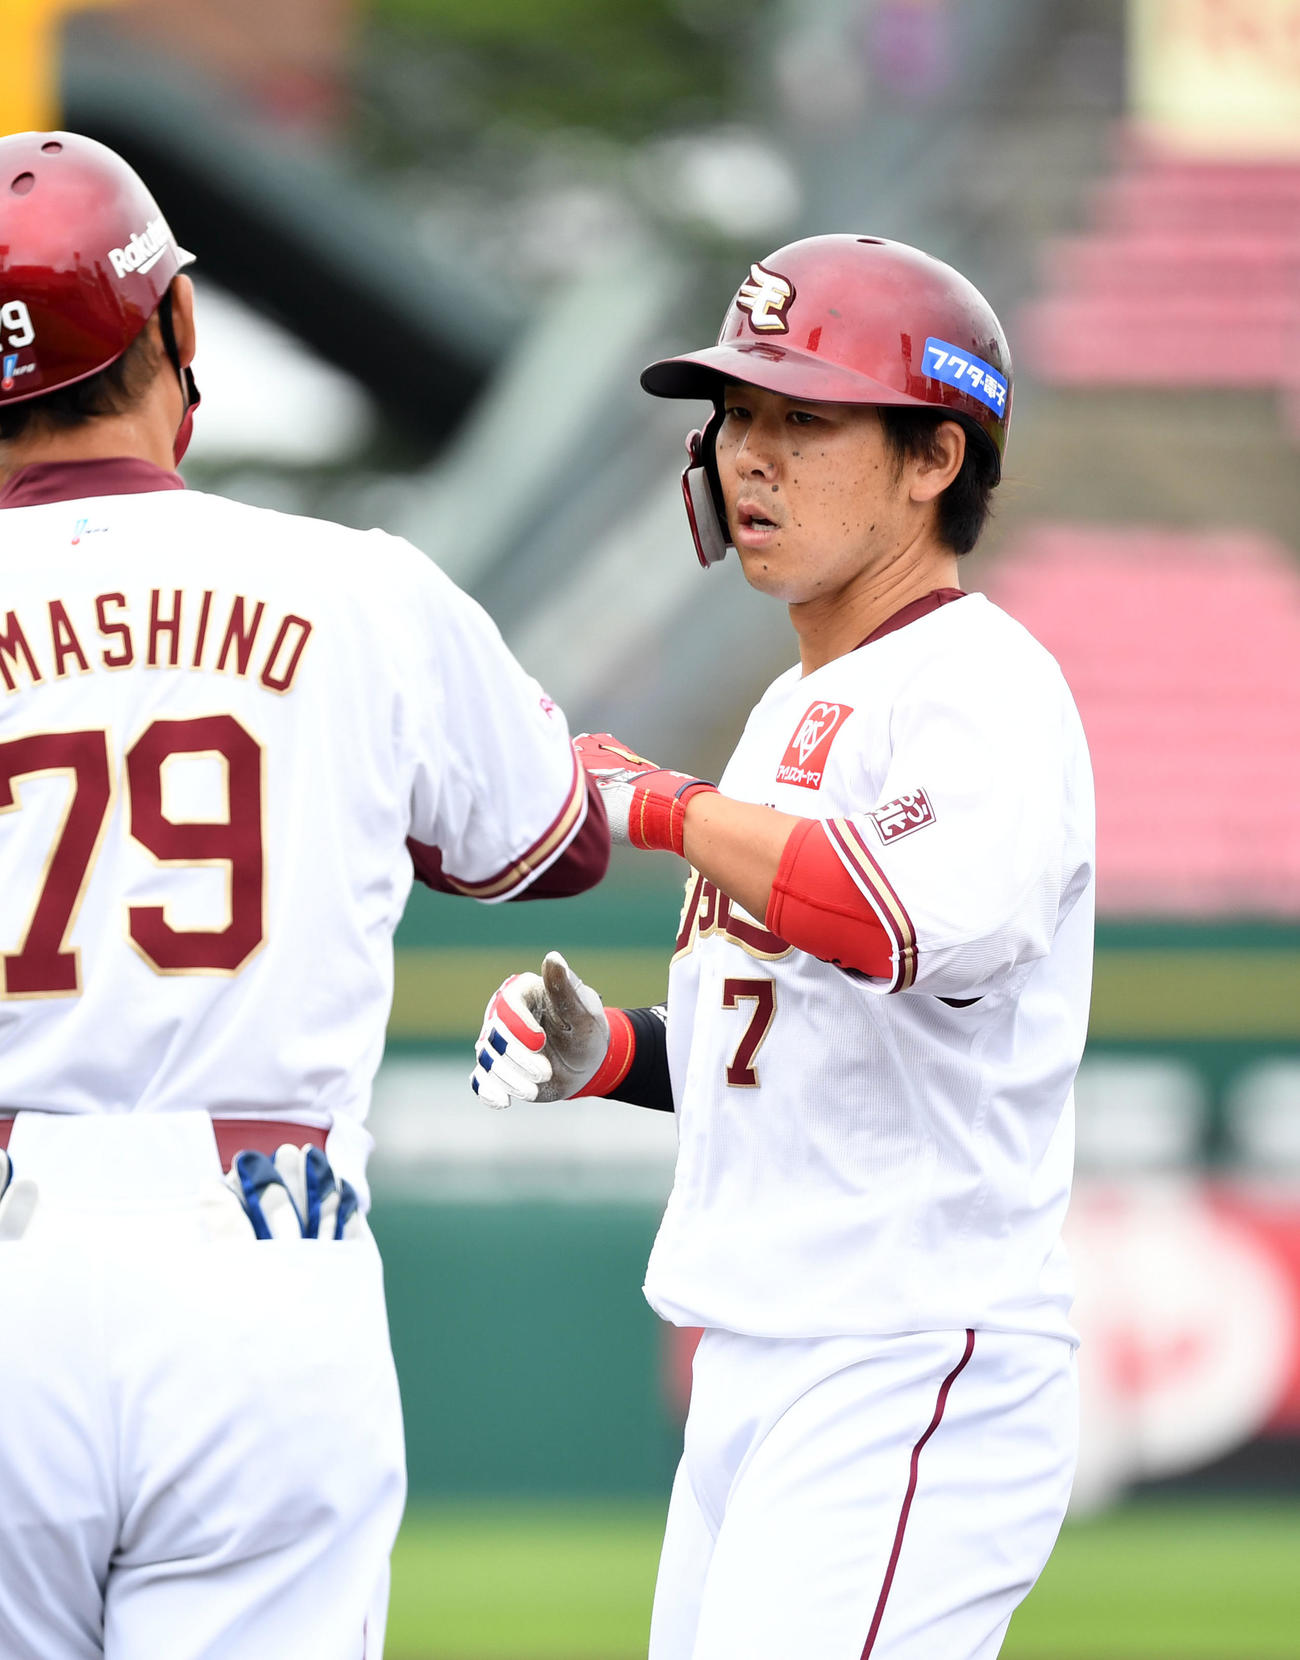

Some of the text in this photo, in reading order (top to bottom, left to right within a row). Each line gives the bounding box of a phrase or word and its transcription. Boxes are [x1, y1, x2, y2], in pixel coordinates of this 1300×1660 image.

[0, 588, 313, 696] MASHINO
[0, 713, 269, 998] 79
[721, 978, 777, 1088] 7
